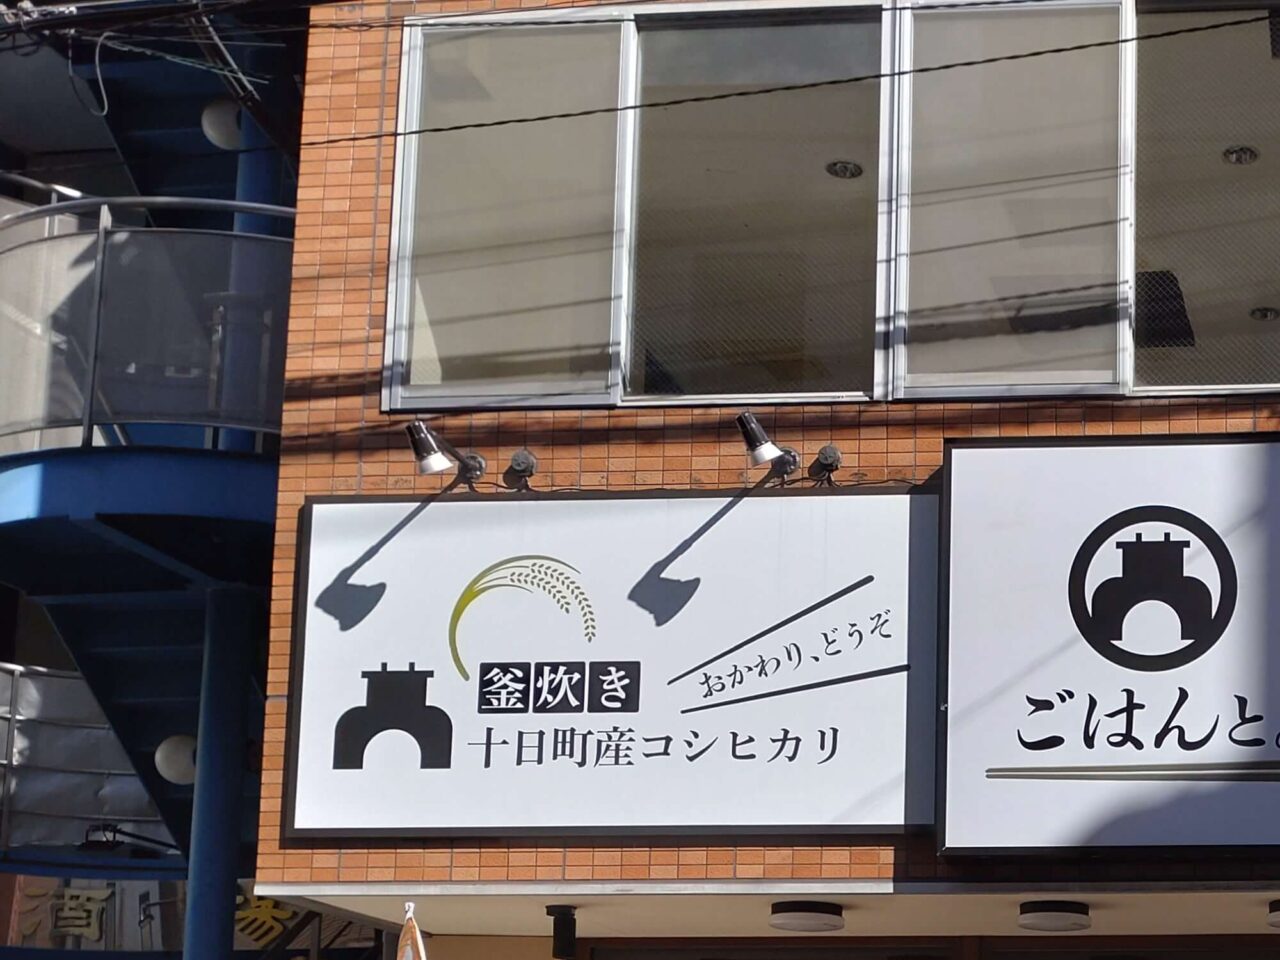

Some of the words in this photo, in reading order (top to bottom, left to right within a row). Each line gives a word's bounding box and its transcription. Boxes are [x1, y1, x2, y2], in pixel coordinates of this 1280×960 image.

[699, 609, 894, 698] おかわり、どうぞ
[480, 664, 638, 712] 釜炊き
[466, 726, 841, 769] 十日町産コシヒカリ
